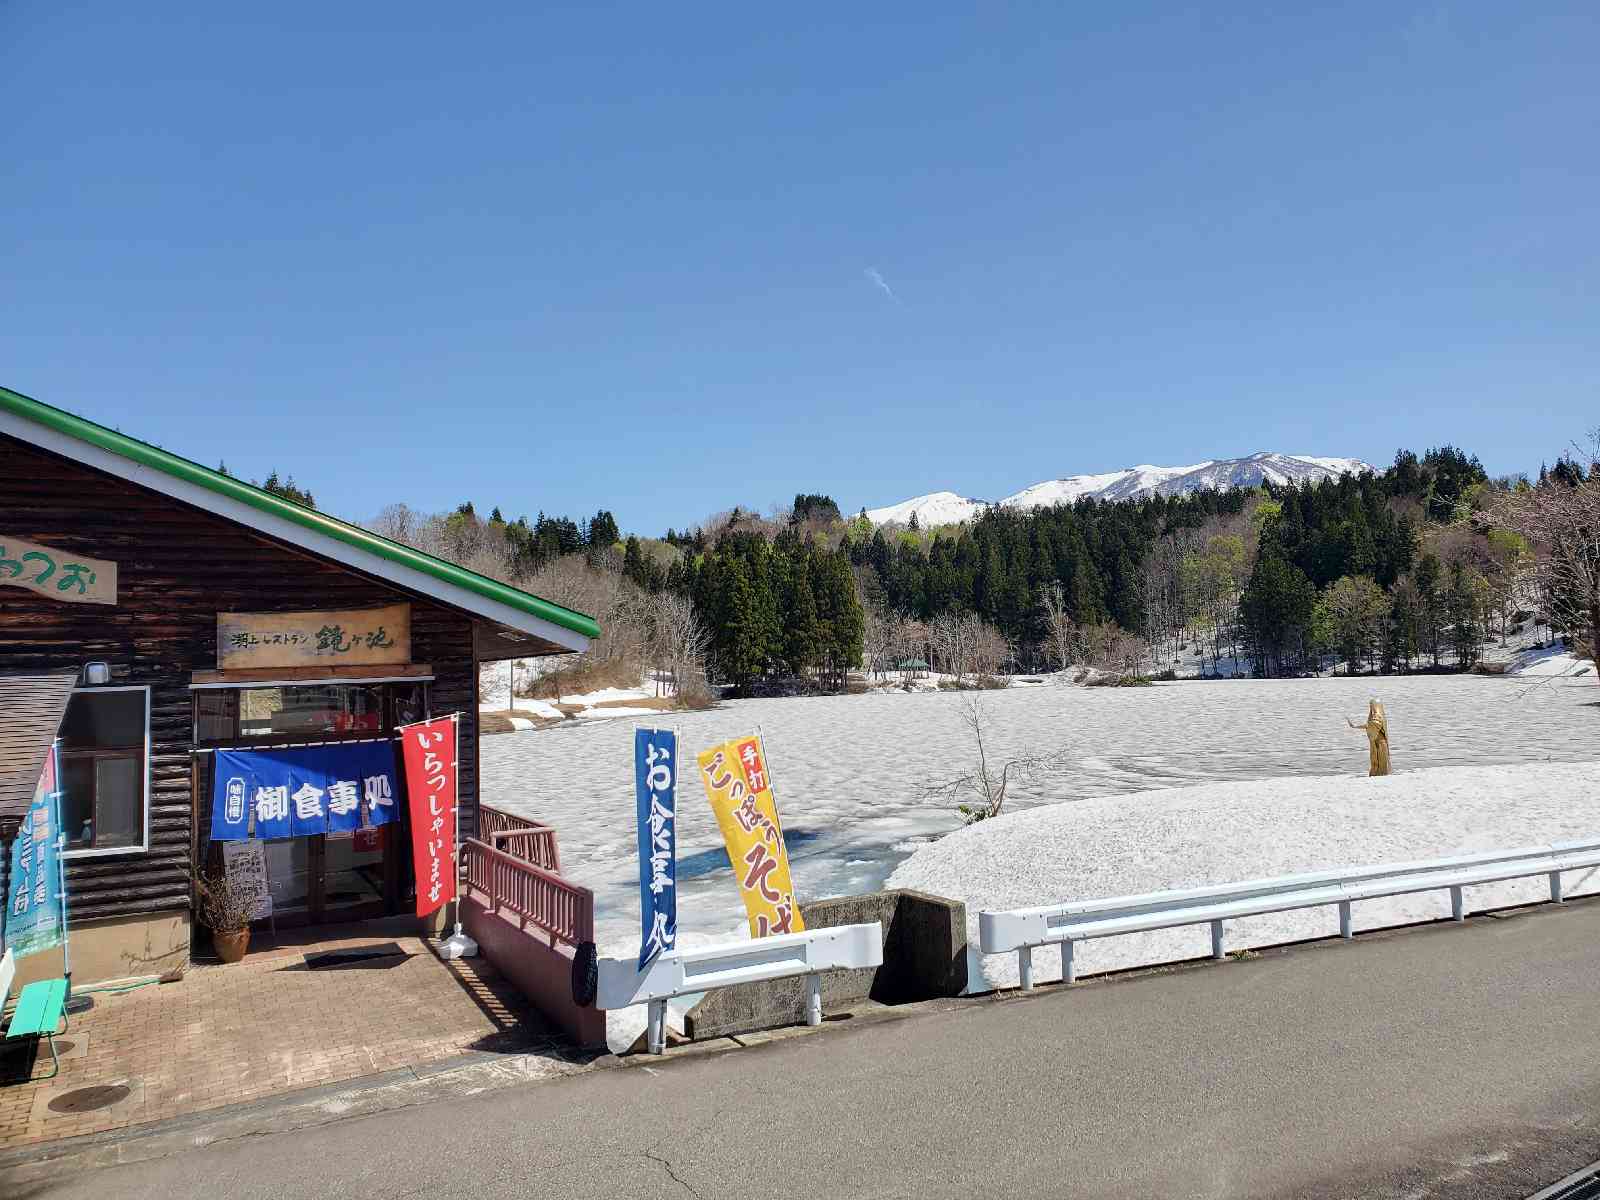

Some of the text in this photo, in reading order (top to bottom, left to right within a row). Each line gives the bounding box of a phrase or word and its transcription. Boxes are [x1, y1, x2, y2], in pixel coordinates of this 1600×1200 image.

[742, 744, 765, 788] 手打
[254, 775, 393, 823] 御食事処
[417, 731, 446, 903] いらっしゃいませ
